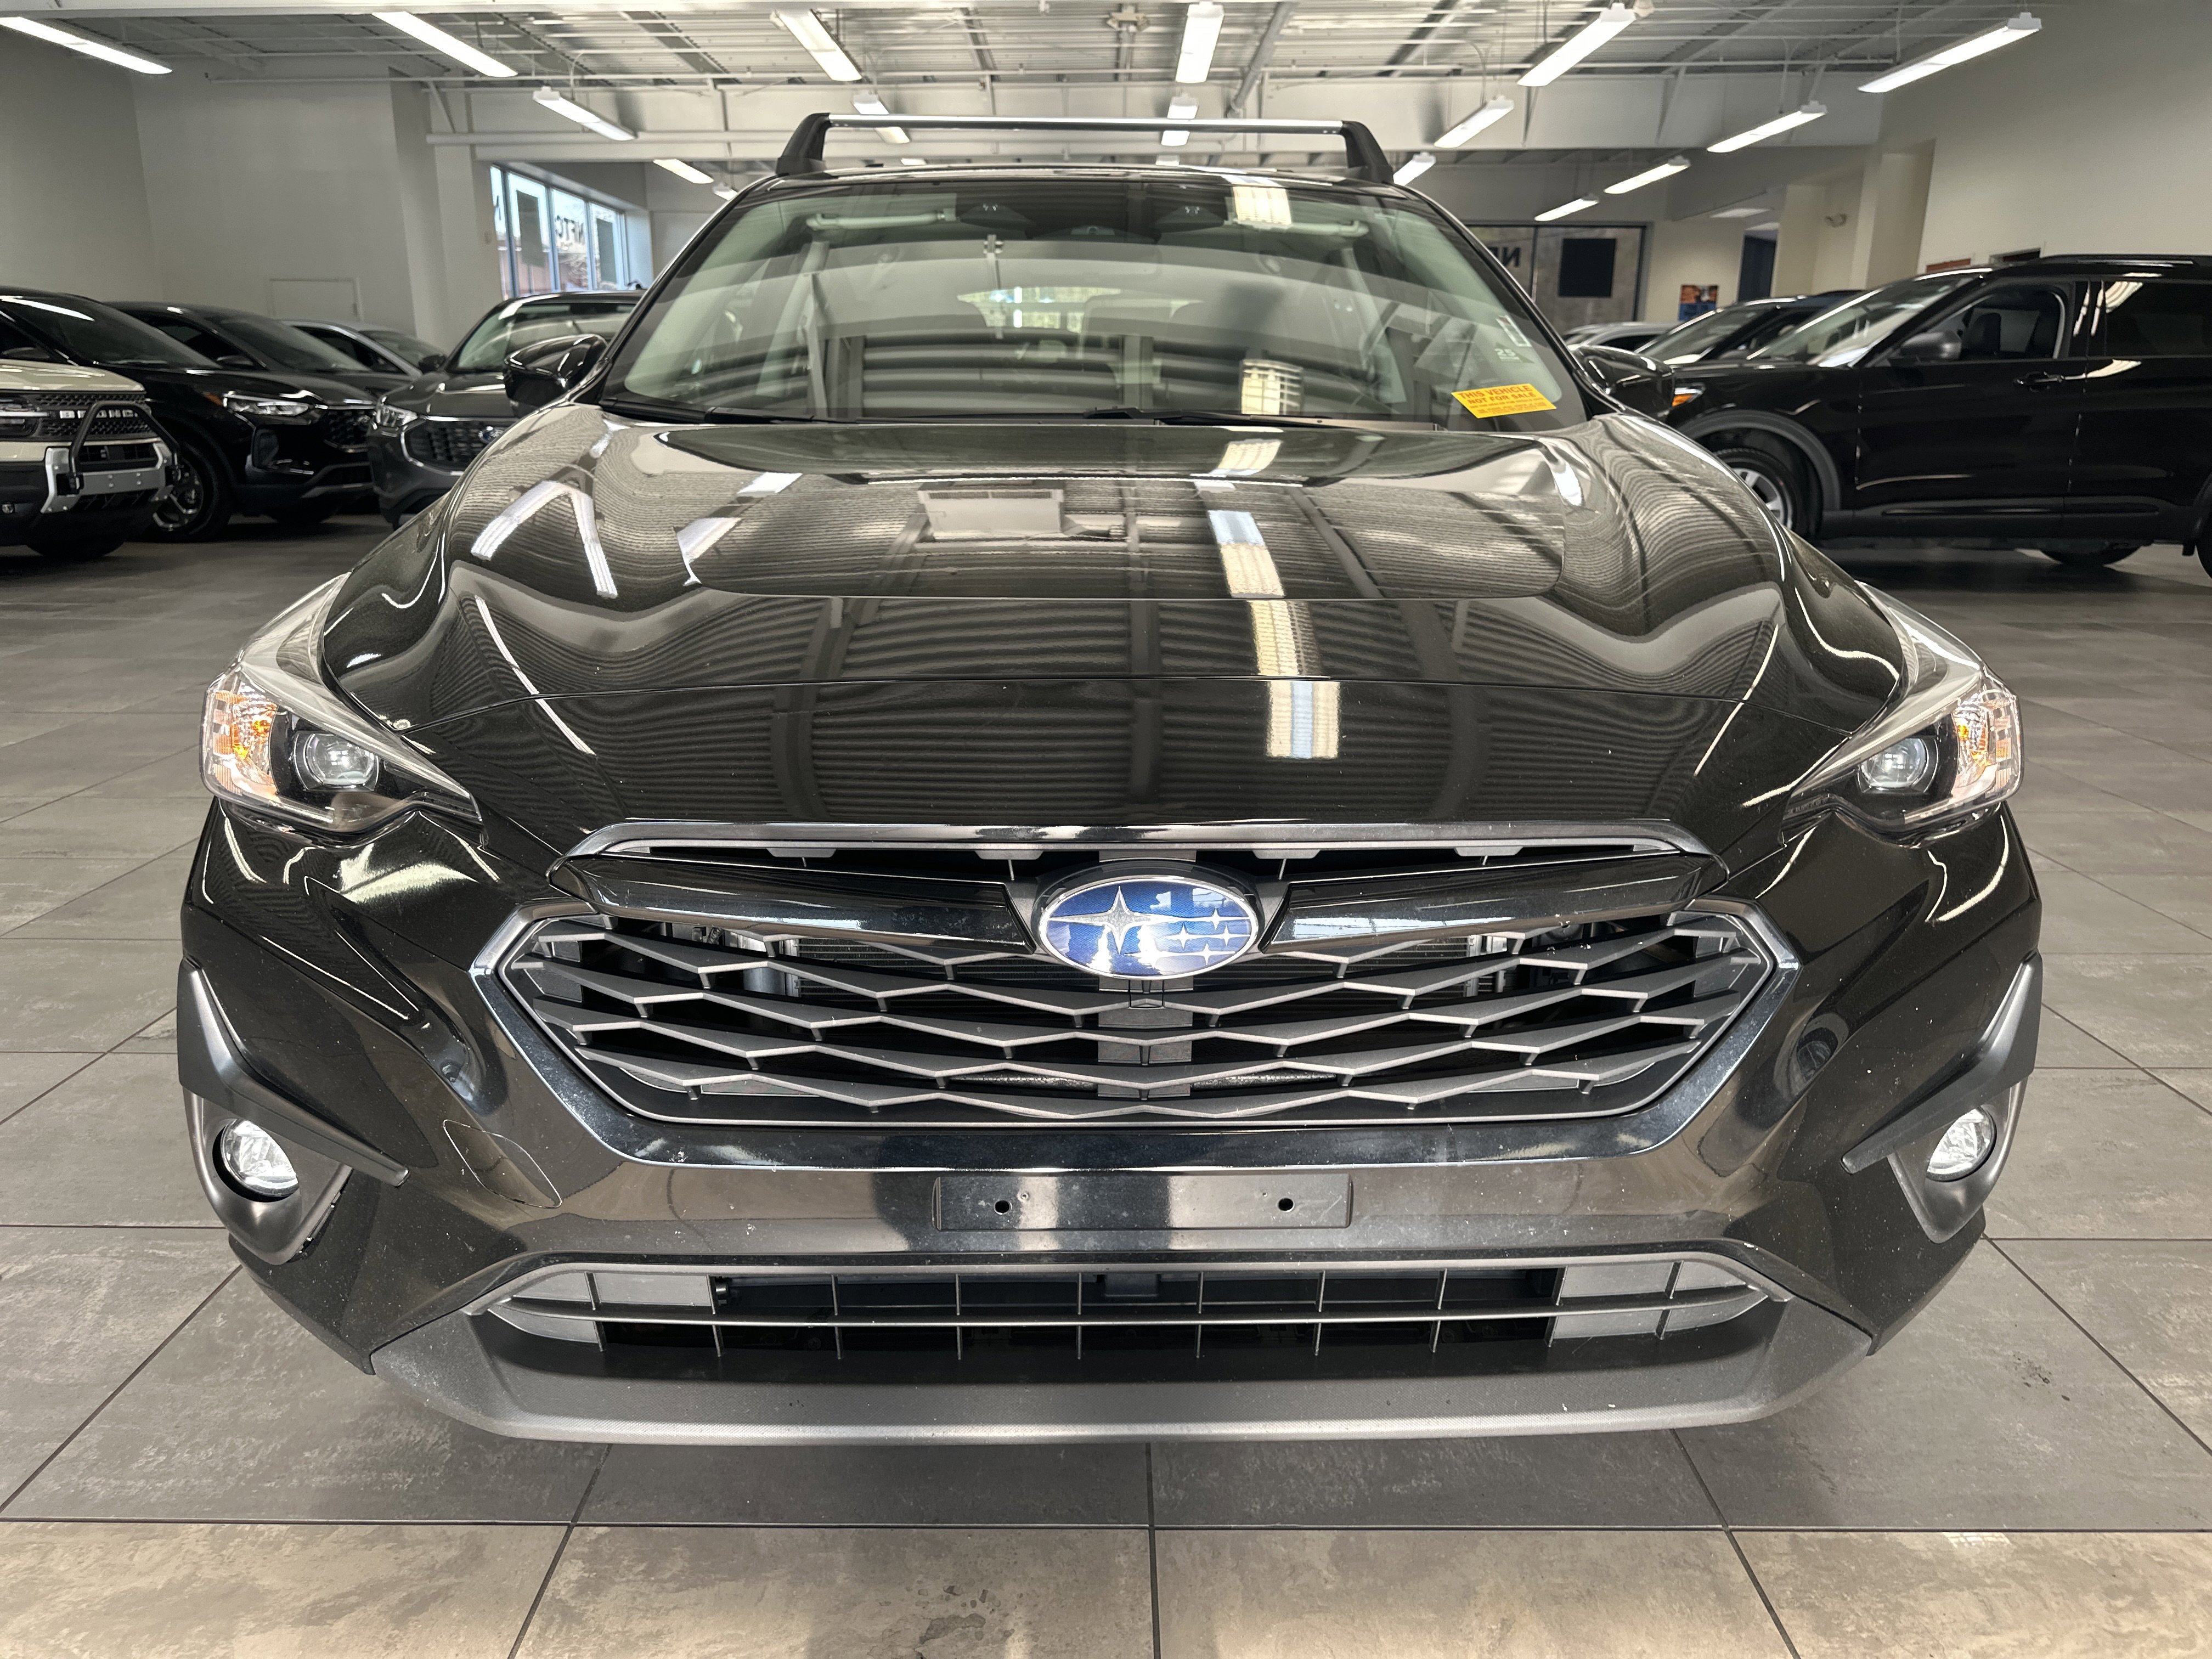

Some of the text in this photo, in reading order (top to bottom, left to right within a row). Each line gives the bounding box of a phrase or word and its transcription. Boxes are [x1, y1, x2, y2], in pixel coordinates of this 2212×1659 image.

[1458, 385, 1532, 399] THIS VEHICLE
[59, 409, 139, 419] BONC
